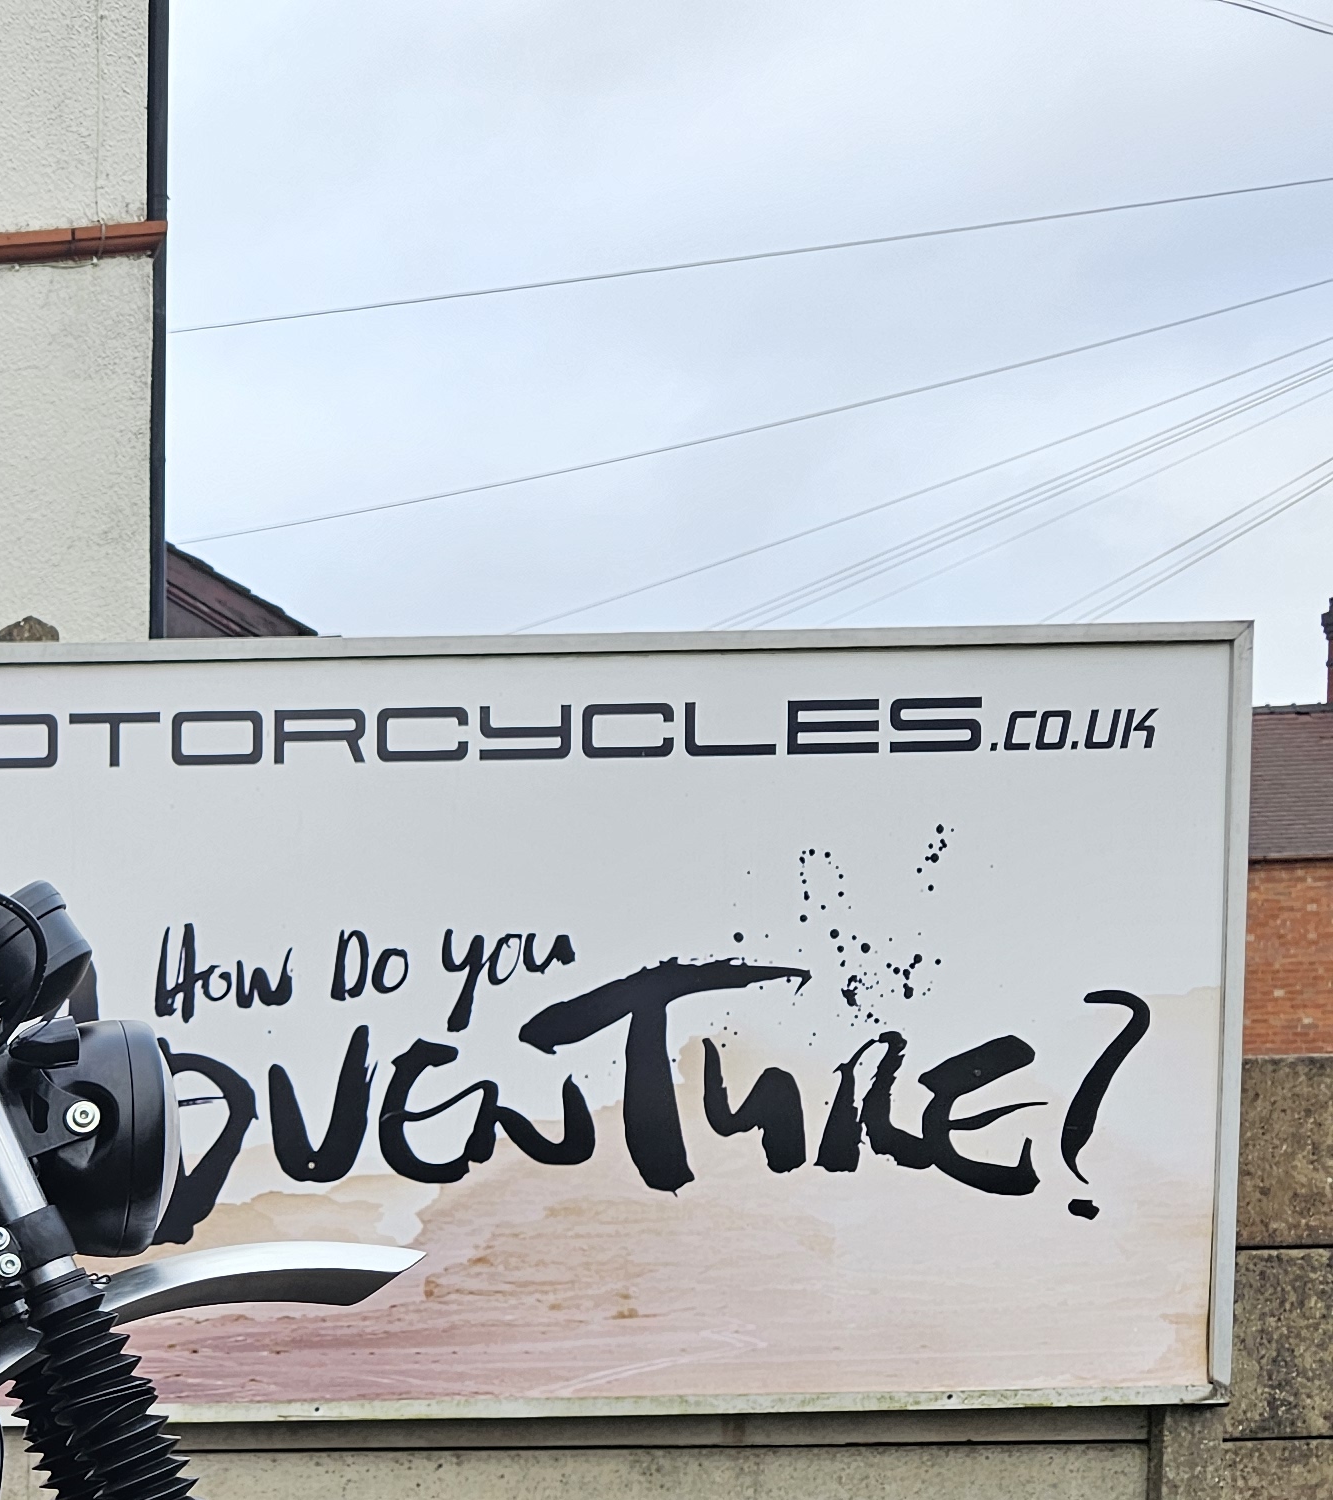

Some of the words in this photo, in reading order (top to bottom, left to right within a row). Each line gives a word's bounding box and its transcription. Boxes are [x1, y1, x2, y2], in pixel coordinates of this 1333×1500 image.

[154, 923, 294, 1024] How
[330, 929, 409, 1001] Do
[441, 928, 576, 1033] you
